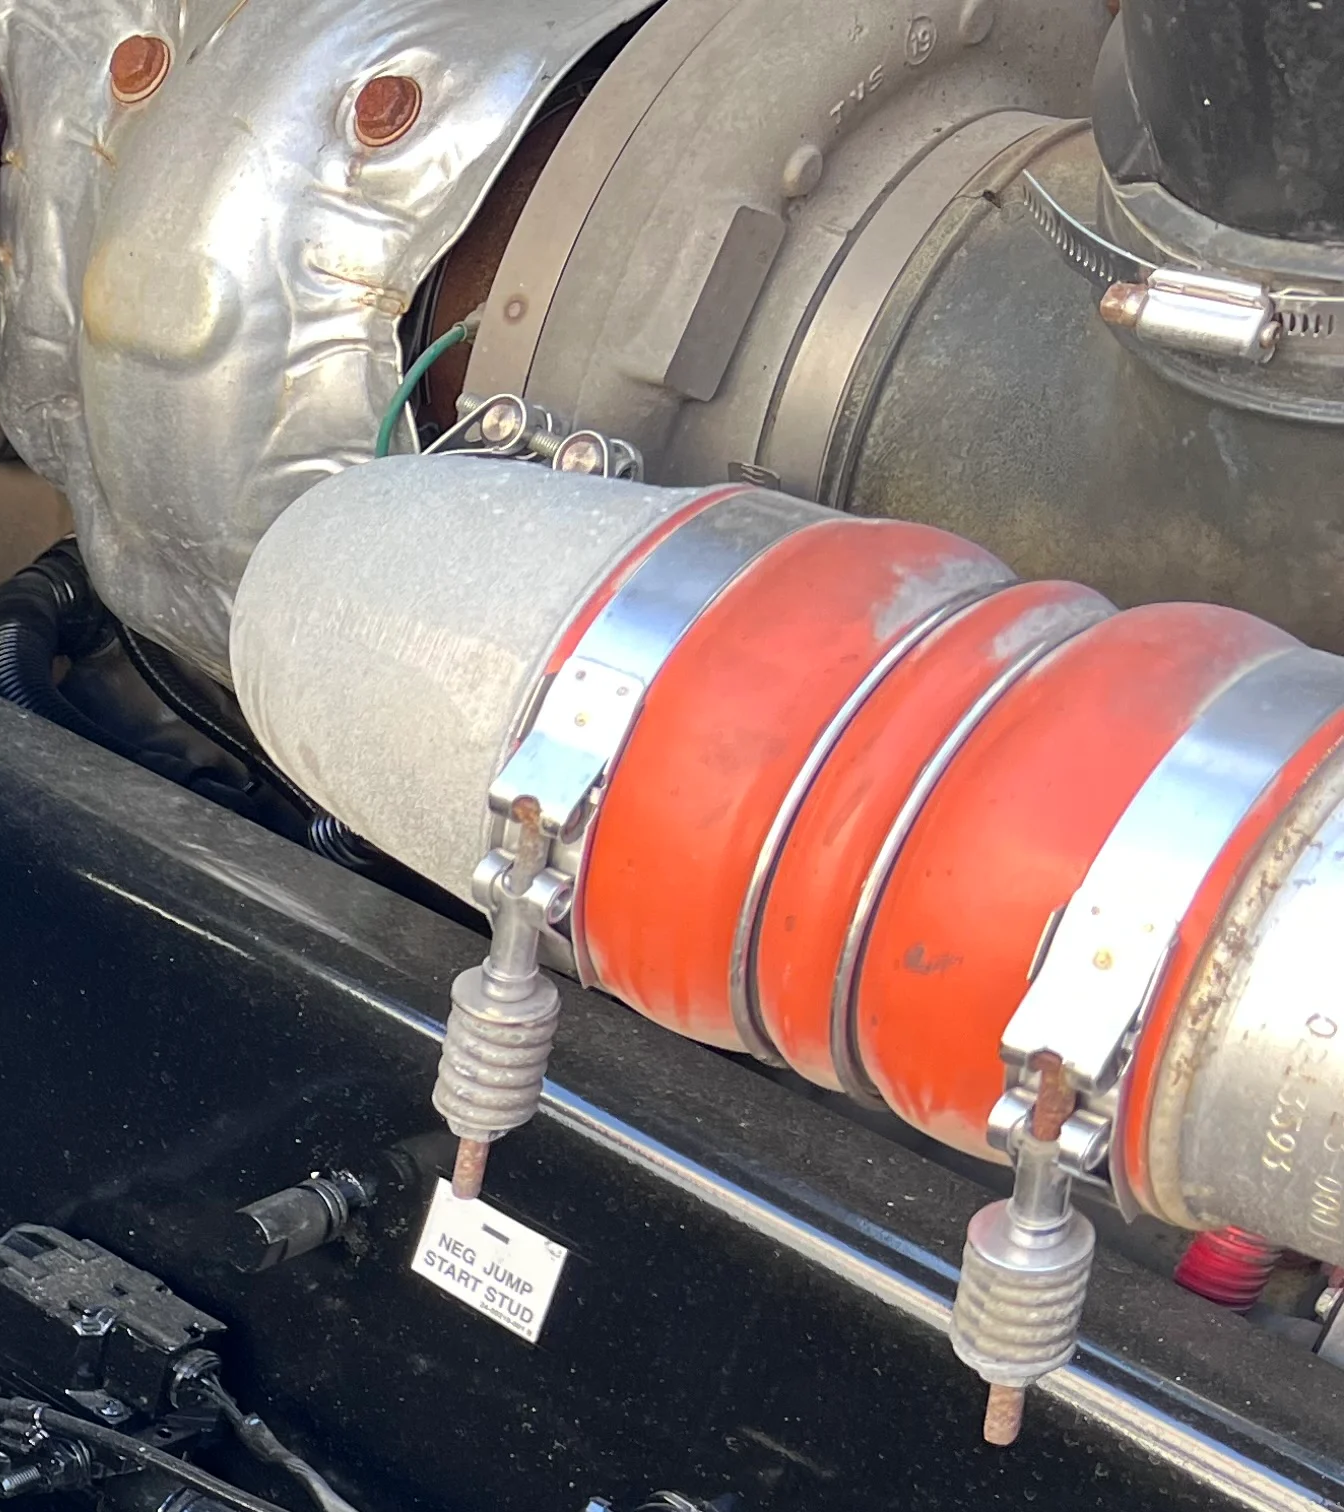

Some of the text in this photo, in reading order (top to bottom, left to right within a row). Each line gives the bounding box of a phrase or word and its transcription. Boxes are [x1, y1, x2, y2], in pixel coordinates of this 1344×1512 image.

[423, 1250, 534, 1323] START STUD
[438, 1233, 533, 1295] NEG JUMP
